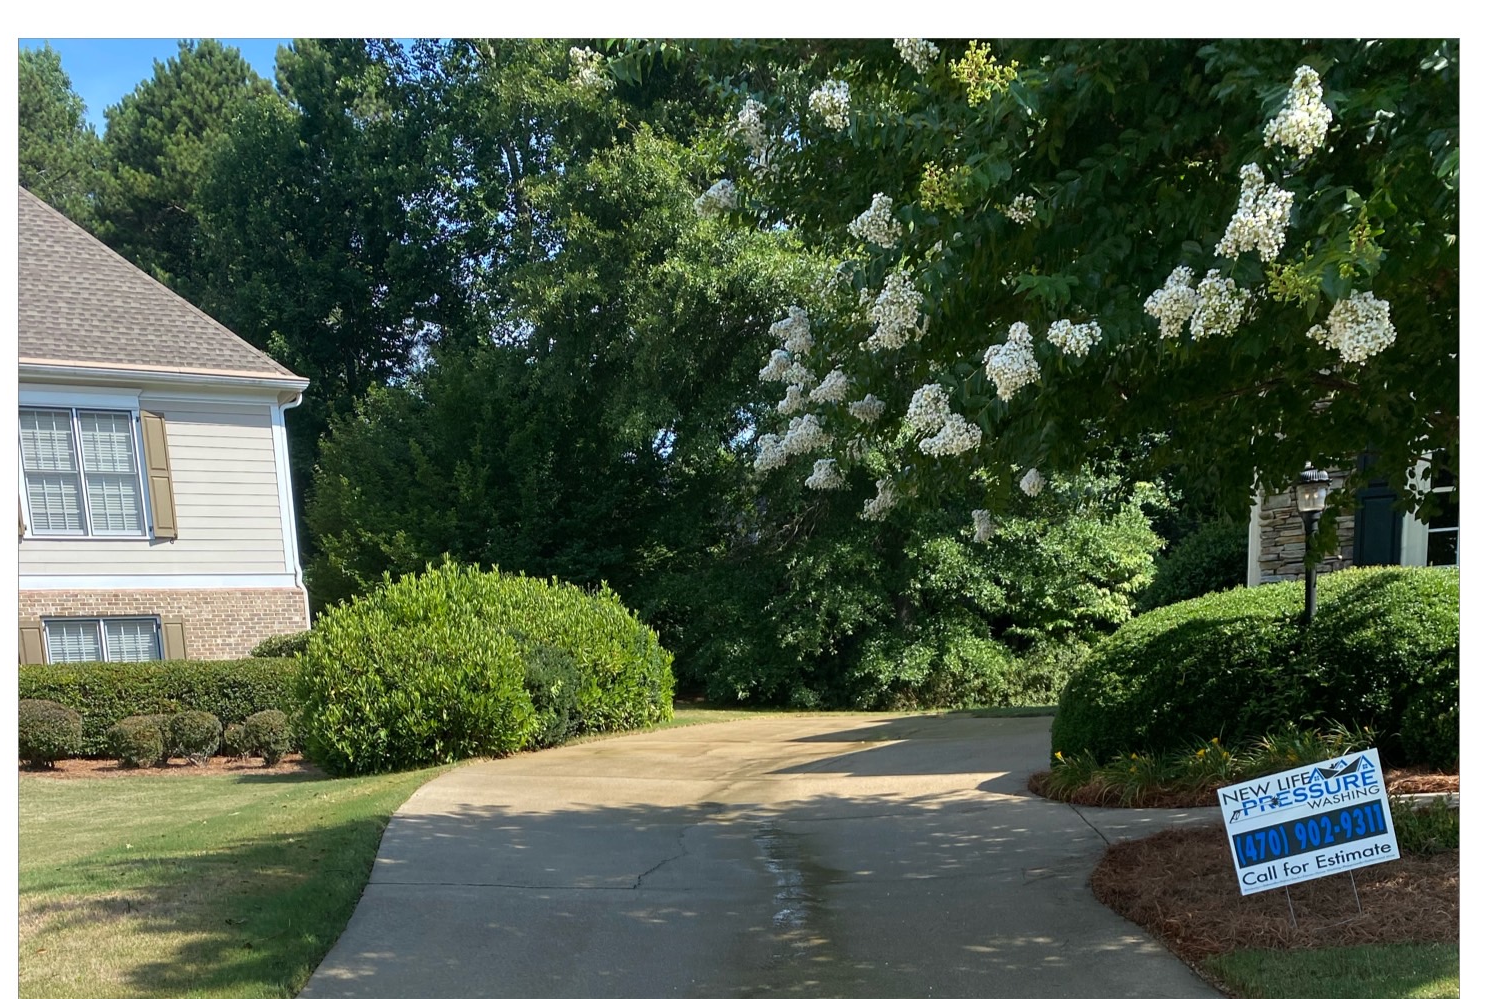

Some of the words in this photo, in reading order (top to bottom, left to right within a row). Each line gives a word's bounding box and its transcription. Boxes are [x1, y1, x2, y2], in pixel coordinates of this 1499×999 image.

[1222, 781, 1270, 805] NEW
[1278, 771, 1311, 791] LIFE
[1242, 769, 1378, 816] PRESSURE
[1307, 785, 1381, 809] WASHING
[1236, 826, 1289, 866] (470)
[1295, 803, 1385, 849] 902-9311
[1242, 865, 1277, 886] Call
[1283, 862, 1309, 877] for
[1316, 843, 1392, 869] Estimate
